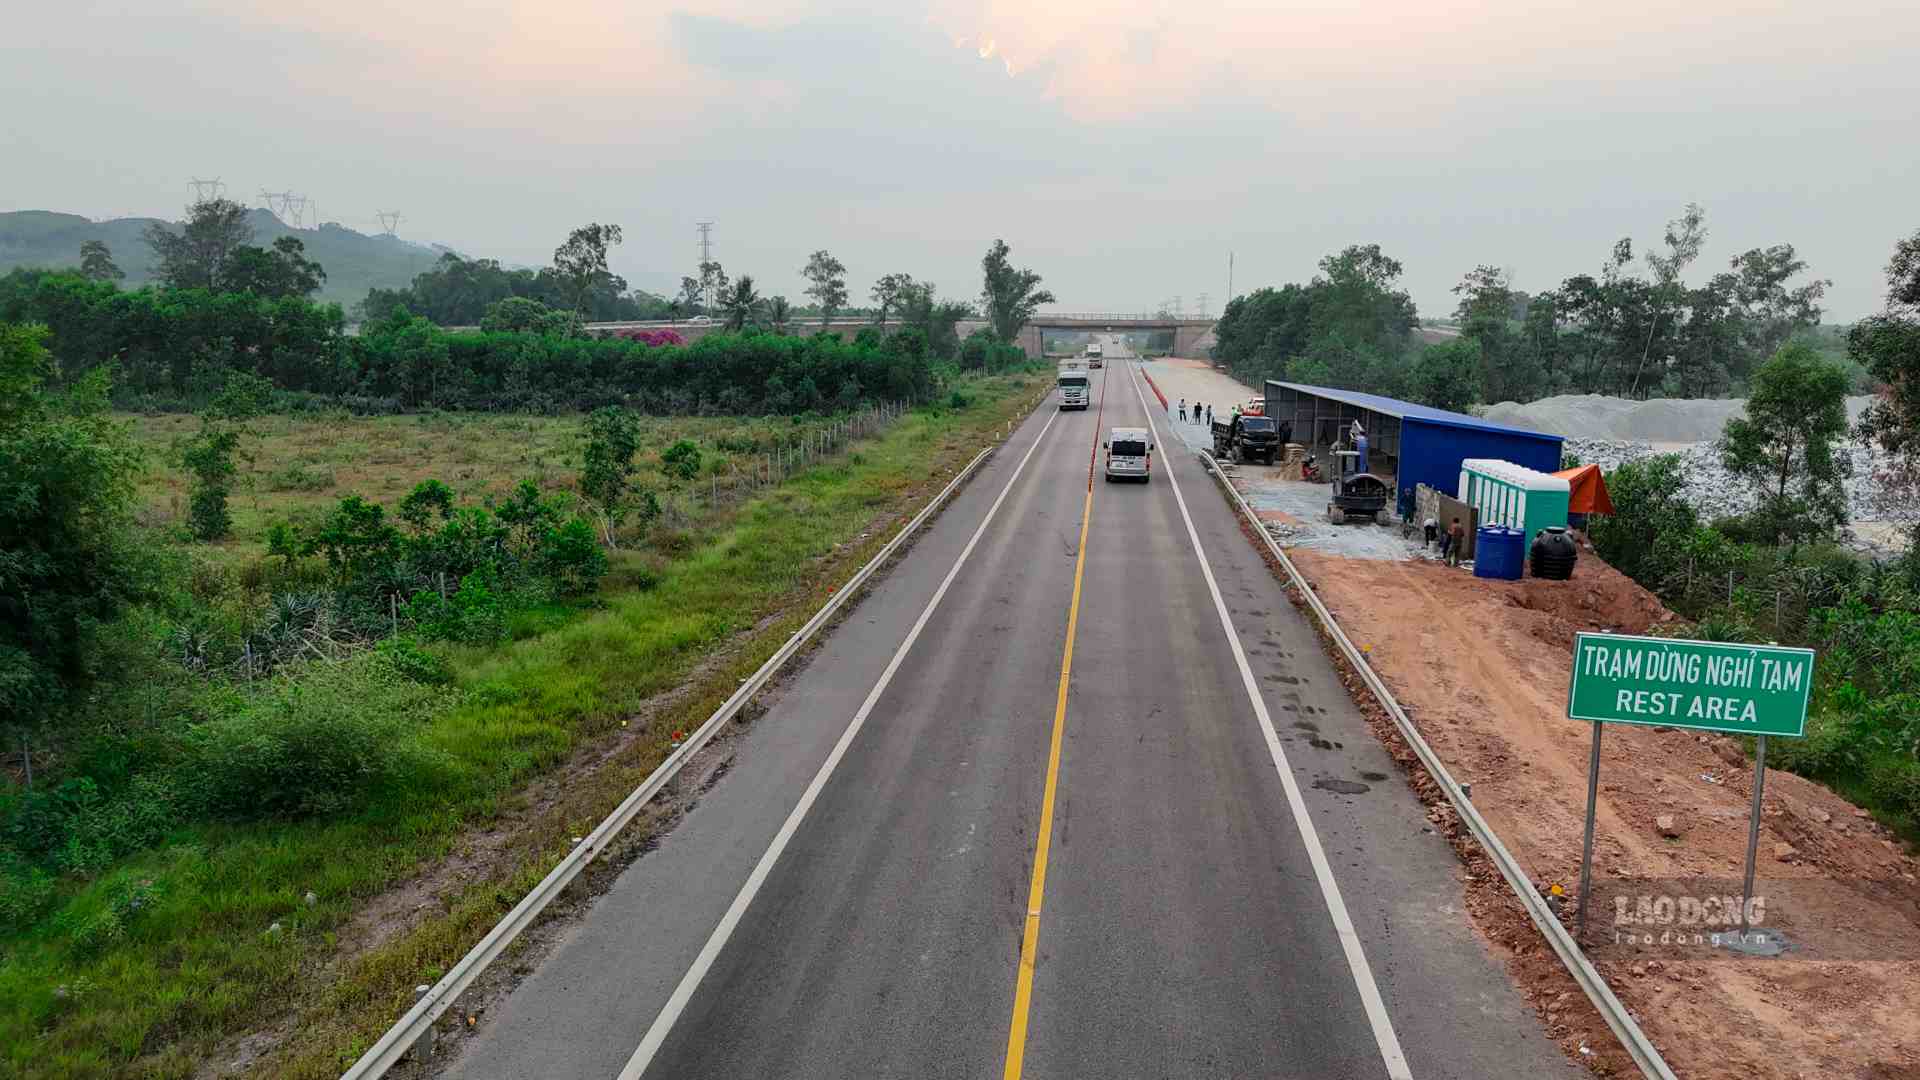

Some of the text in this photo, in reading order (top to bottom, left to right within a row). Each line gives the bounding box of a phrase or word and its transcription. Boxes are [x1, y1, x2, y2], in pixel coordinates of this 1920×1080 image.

[1584, 645, 1803, 694] TRẠM DỪNG NGHỈ TẠM
[1615, 689, 1758, 723] REST AREA
